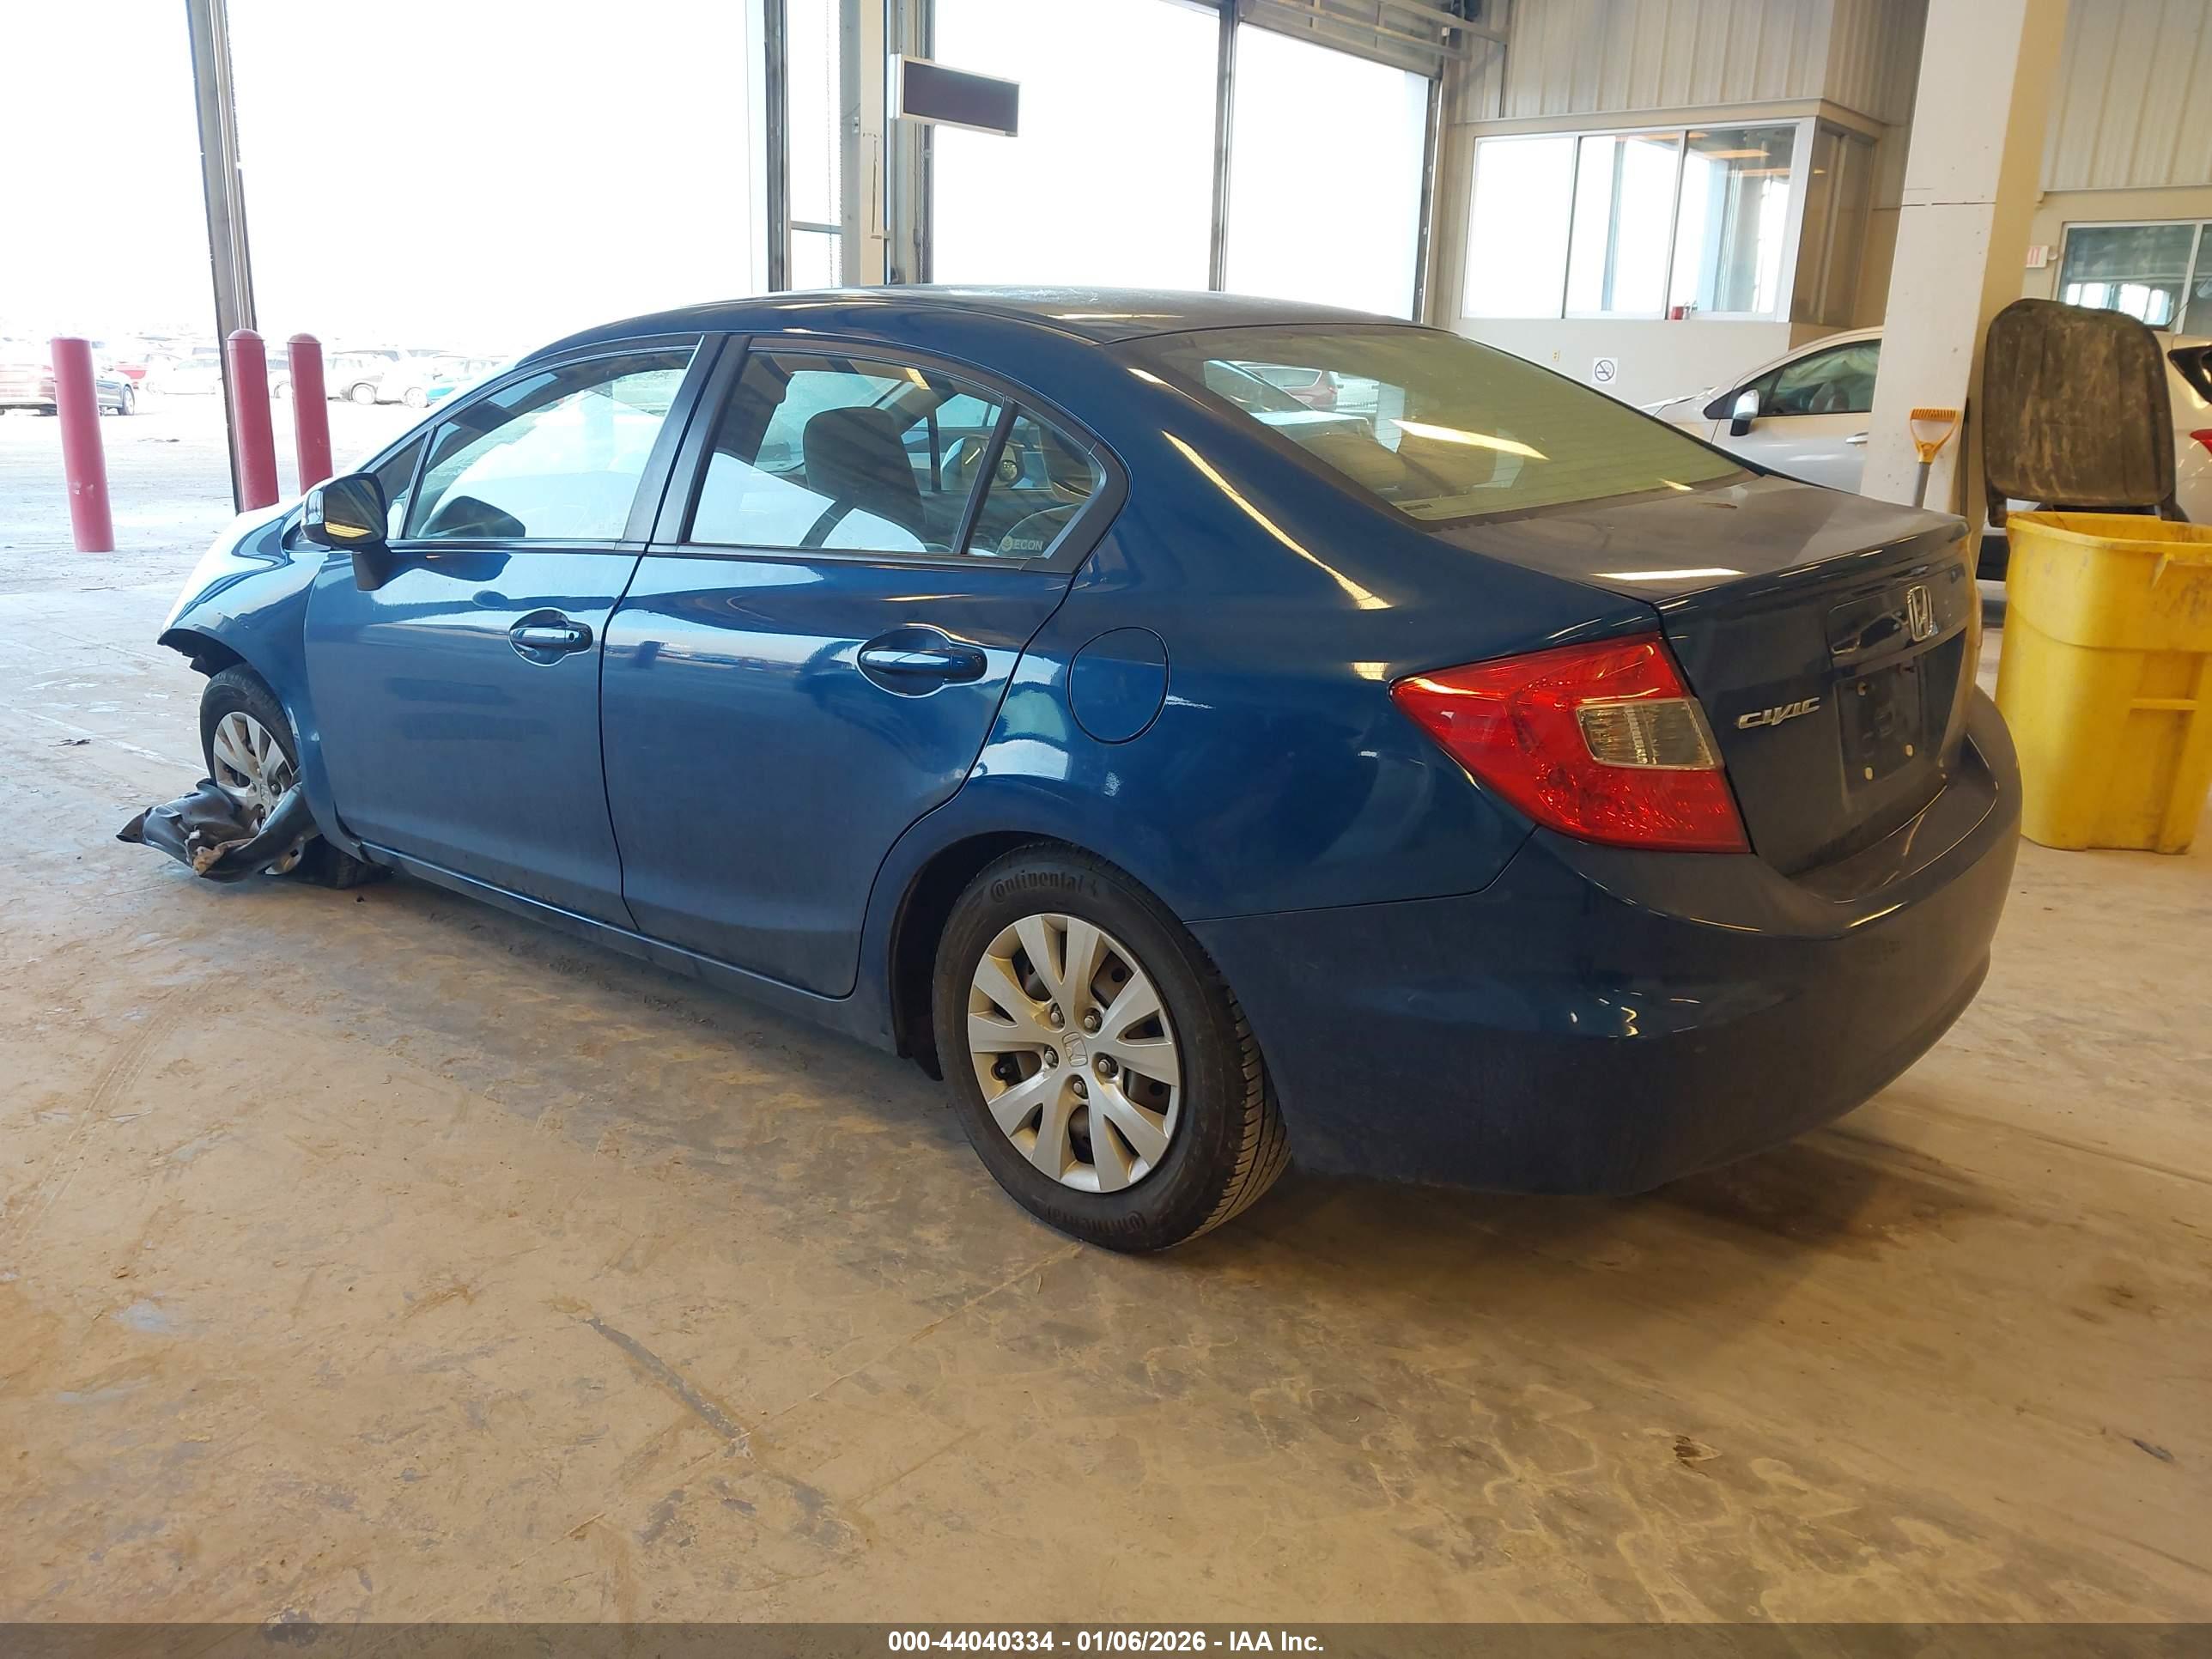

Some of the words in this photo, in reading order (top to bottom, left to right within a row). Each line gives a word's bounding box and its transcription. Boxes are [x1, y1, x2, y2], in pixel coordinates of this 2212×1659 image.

[1013, 538, 1043, 550] ECON
[1736, 696, 1820, 730] CIVIC
[990, 870, 1085, 903] Continental
